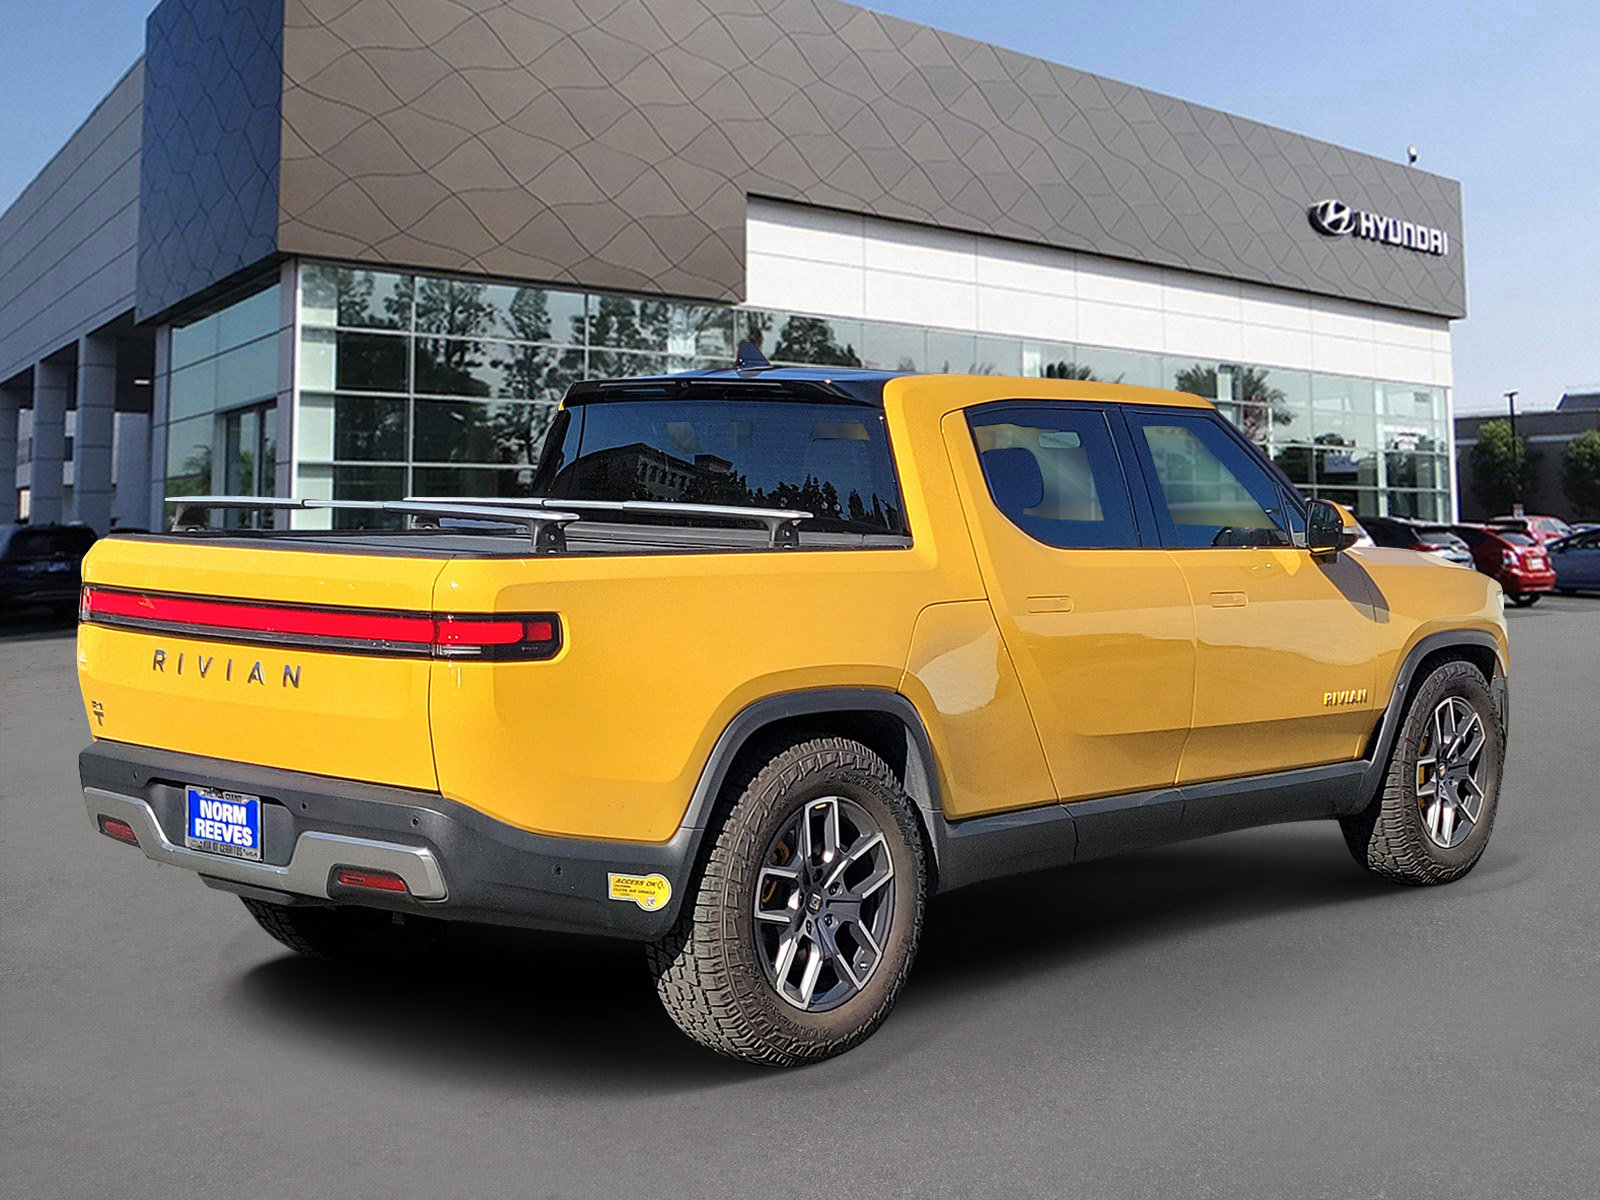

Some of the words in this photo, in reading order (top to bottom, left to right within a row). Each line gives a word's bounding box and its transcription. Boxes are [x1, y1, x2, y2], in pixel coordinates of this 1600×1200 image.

[1360, 211, 1448, 255] HYUNDAI
[152, 649, 301, 689] RIVIAN
[1322, 689, 1367, 706] RIVIAN
[200, 799, 247, 826] NORM
[195, 817, 253, 847] REEVES
[615, 878, 645, 886] ACCESS
